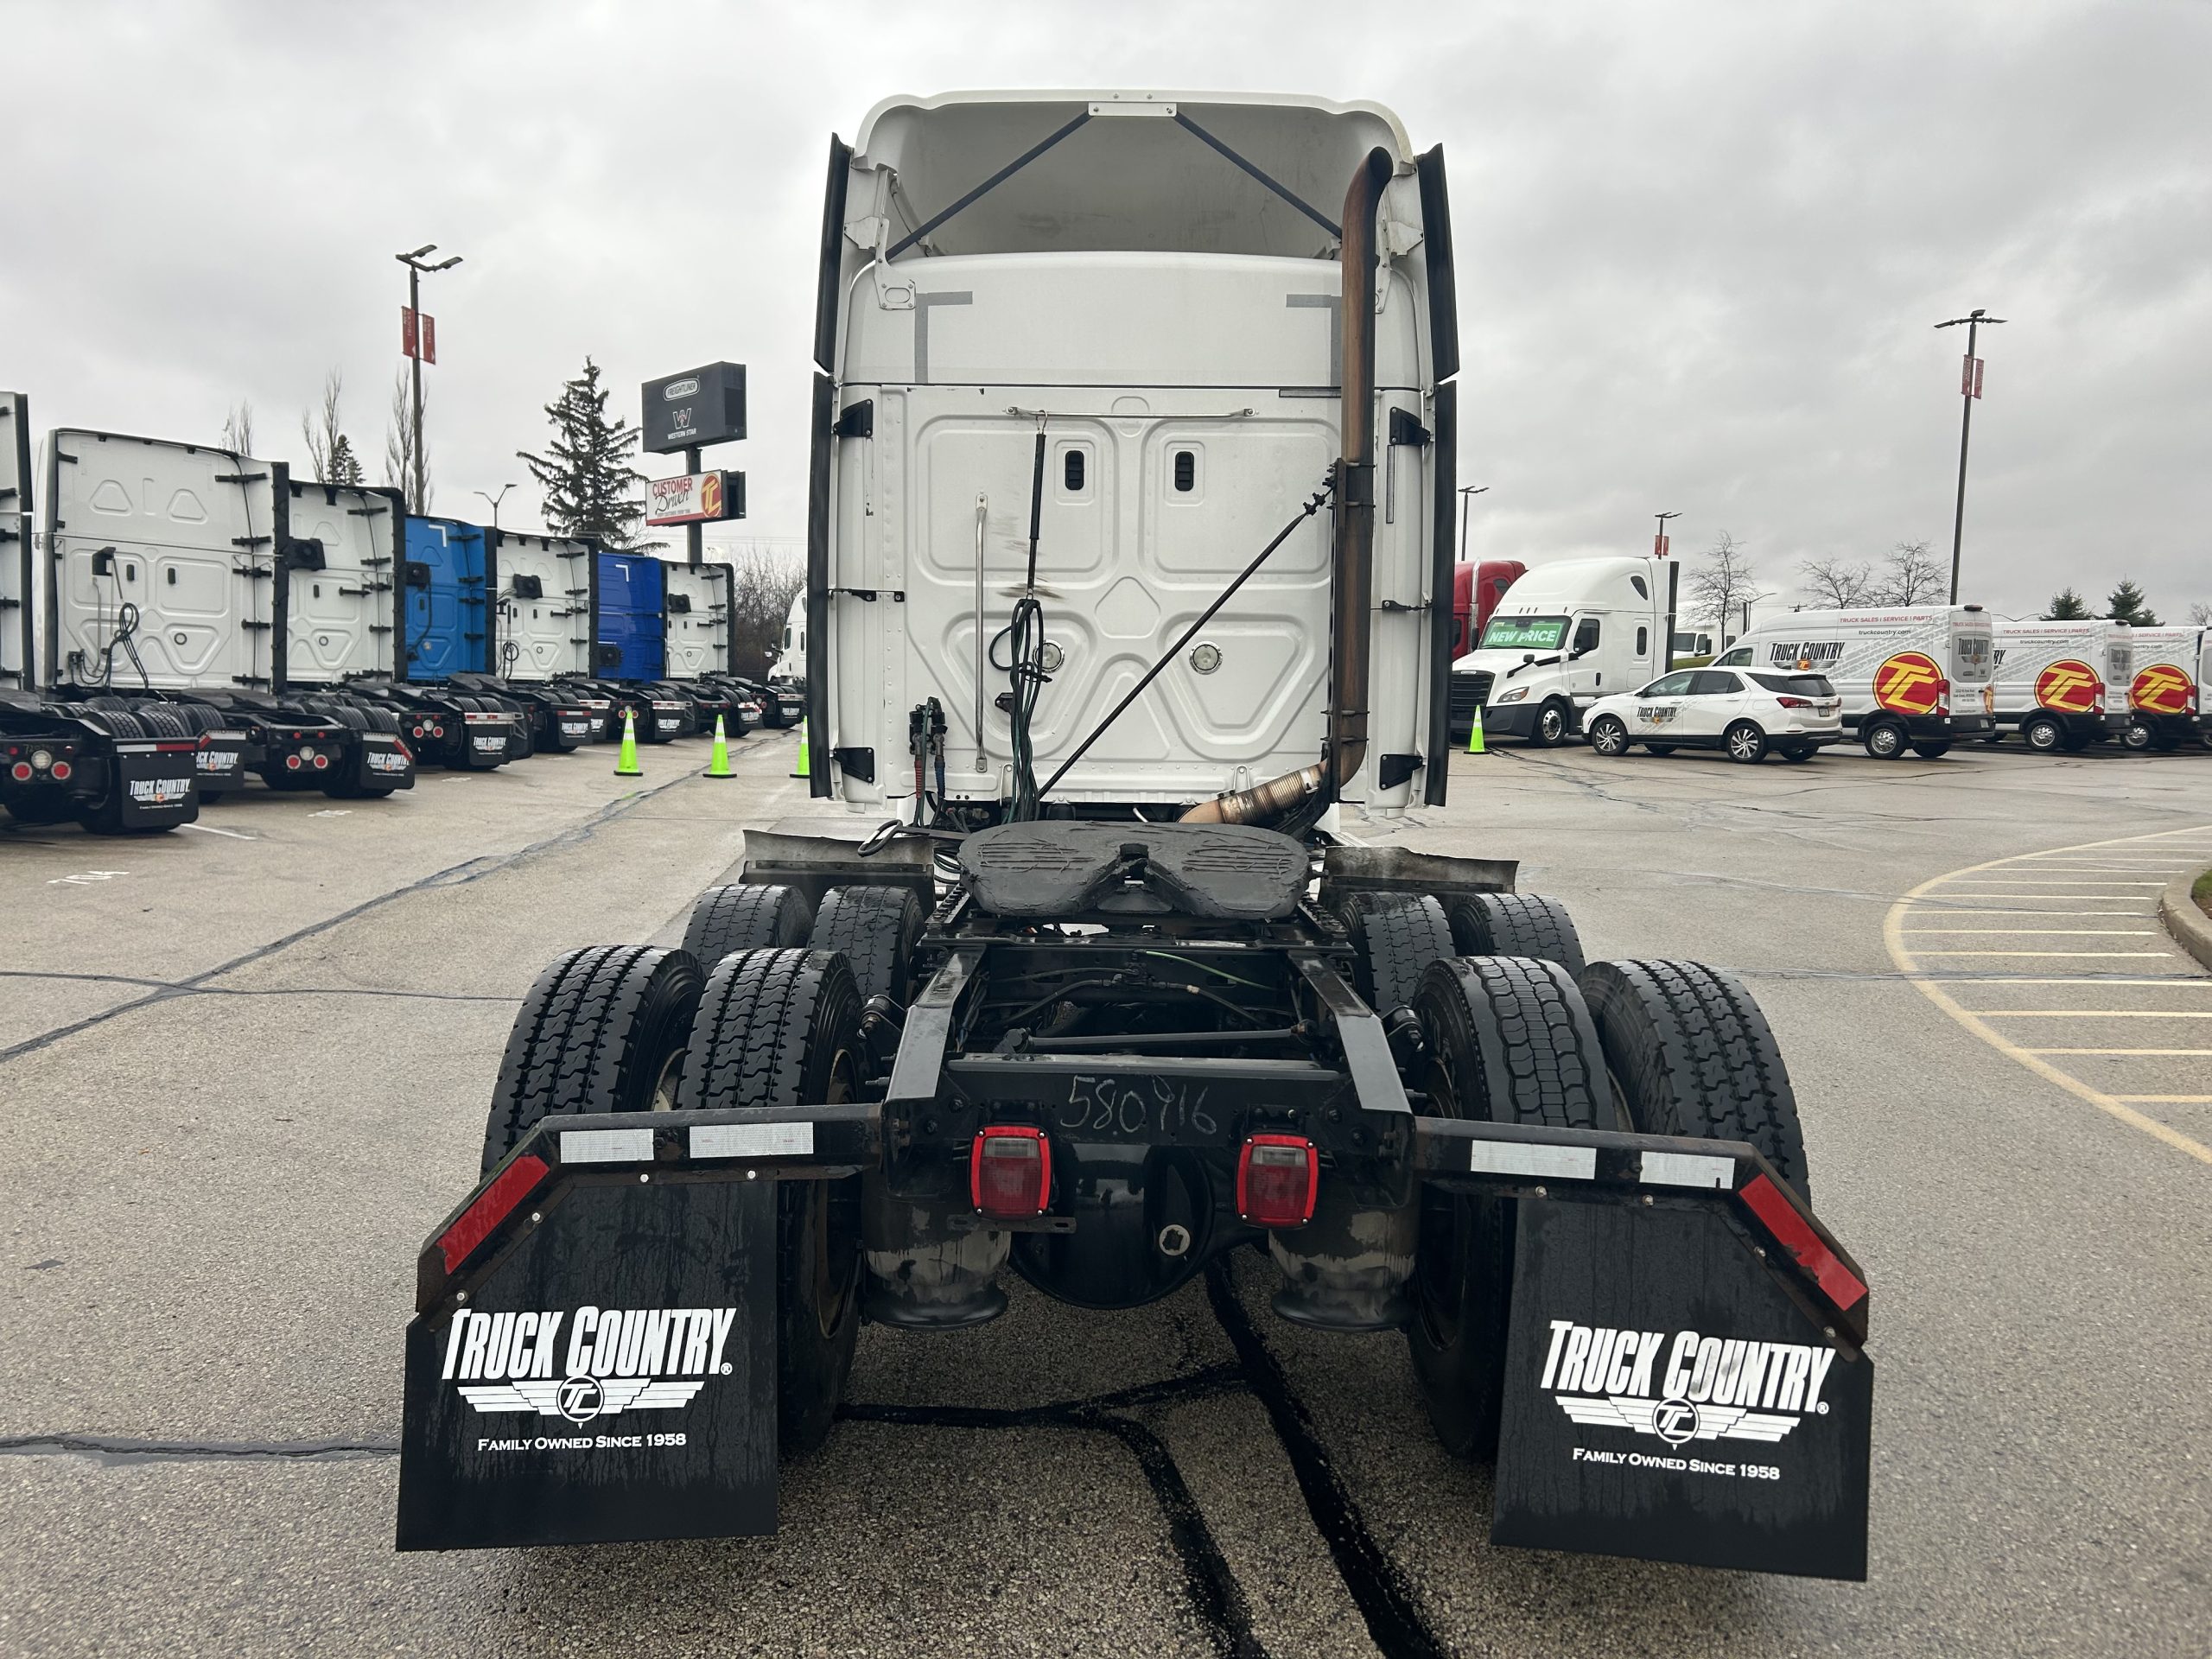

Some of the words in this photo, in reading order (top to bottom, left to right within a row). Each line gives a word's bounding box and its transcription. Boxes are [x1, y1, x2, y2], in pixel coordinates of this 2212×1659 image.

[667, 382, 696, 396] FREIGHTLINER
[667, 430, 685, 440] WESTERN
[686, 428, 696, 436] STAR
[652, 477, 693, 497] CUSTOMER
[1489, 631, 1518, 642] NEW
[1516, 630, 1557, 642] PRICE
[1770, 643, 1801, 661] TRUCK
[1801, 642, 1845, 660] COUNTRY
[1637, 707, 1654, 717] TRUCK
[130, 780, 155, 795] TRUCK
[156, 779, 190, 794] COUNTRY
[442, 1308, 563, 1380] TRUCK
[565, 1306, 737, 1377] COUNTRY
[1541, 1319, 1665, 1397] TRUCK
[1662, 1331, 1836, 1413] COUNTRY
[478, 1438, 532, 1452] FAMILY
[535, 1436, 593, 1450] OWNED
[595, 1434, 642, 1448] SINCE
[646, 1433, 687, 1446] 1958
[1573, 1447, 1628, 1465] FAMILY
[1629, 1452, 1687, 1471] OWNED
[1688, 1459, 1736, 1476] SINCE
[1739, 1464, 1780, 1480] 1958
